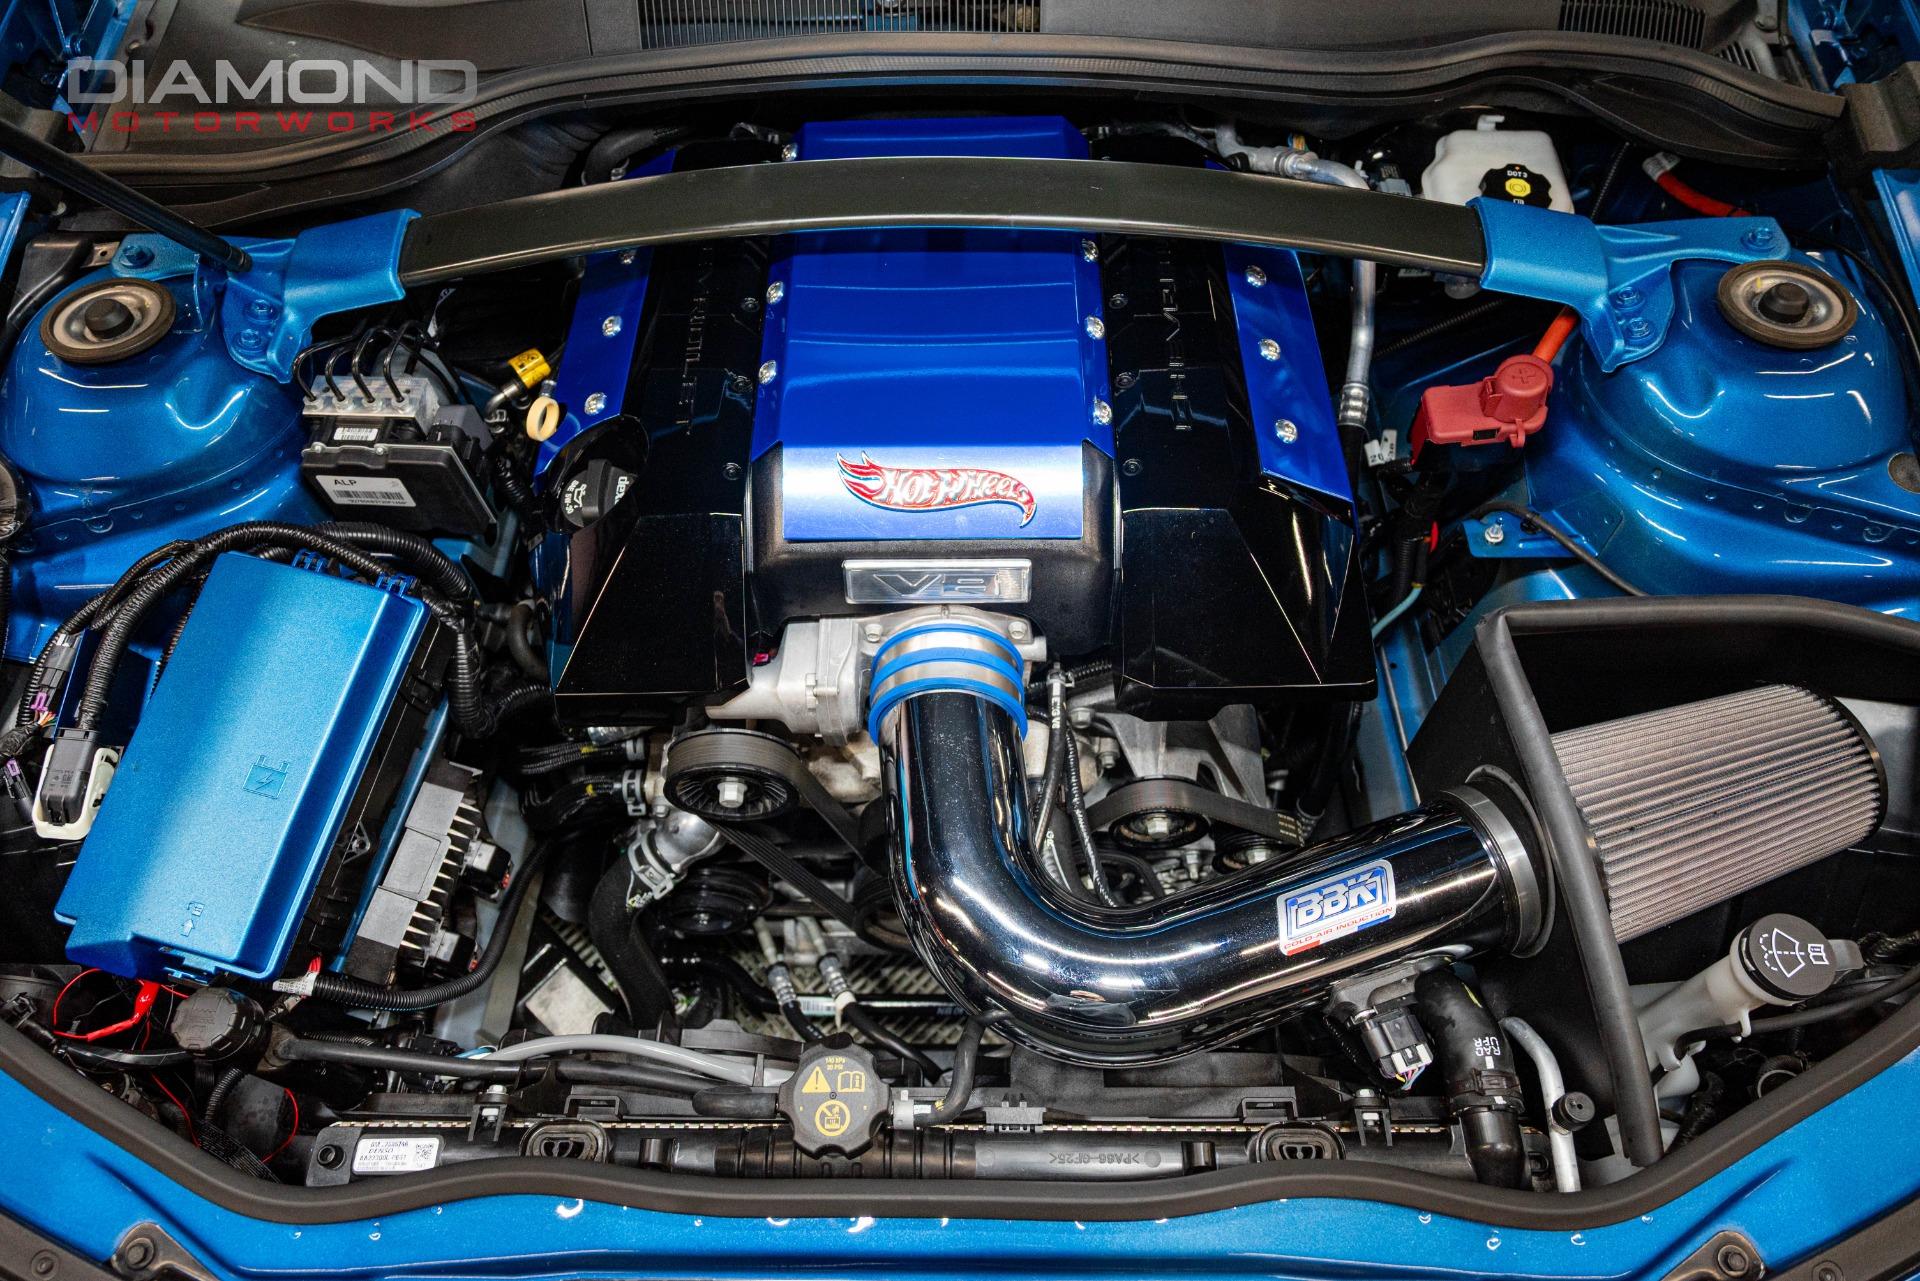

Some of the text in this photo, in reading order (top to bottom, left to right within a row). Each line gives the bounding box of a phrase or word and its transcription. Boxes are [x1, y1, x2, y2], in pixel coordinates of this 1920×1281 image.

[564, 480, 579, 514] SAE 5W-30
[1296, 870, 1378, 928] BBK
[1284, 906, 1394, 949] COLD AIR INDUCTION
